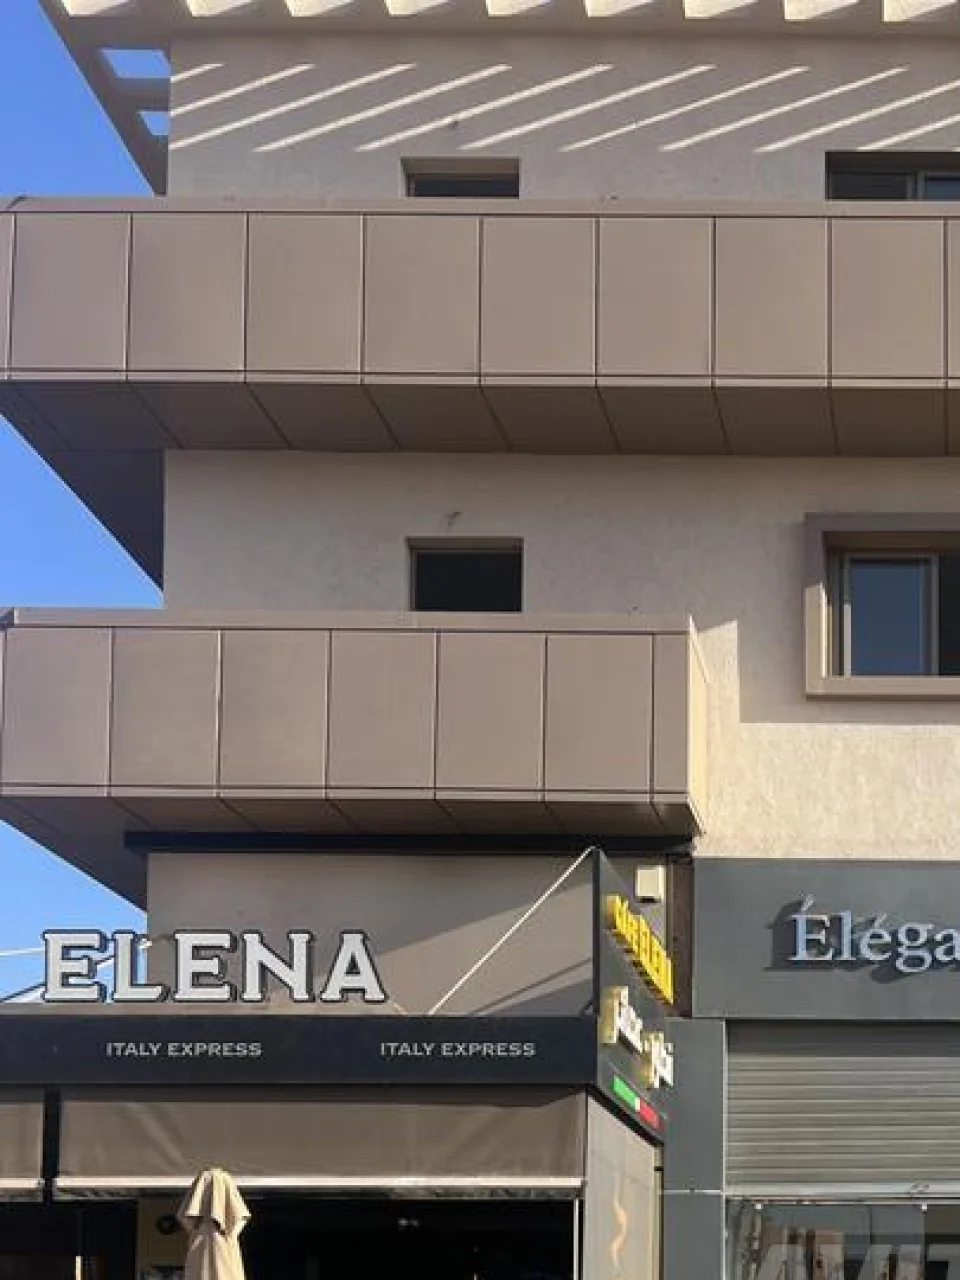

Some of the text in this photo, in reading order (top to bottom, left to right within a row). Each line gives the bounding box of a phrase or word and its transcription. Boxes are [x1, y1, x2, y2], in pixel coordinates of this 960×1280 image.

[43, 928, 386, 1003] ELENA
[106, 1042, 262, 1056] ITALY EXPRESS
[380, 1042, 537, 1056] ITALY EXPRESS
